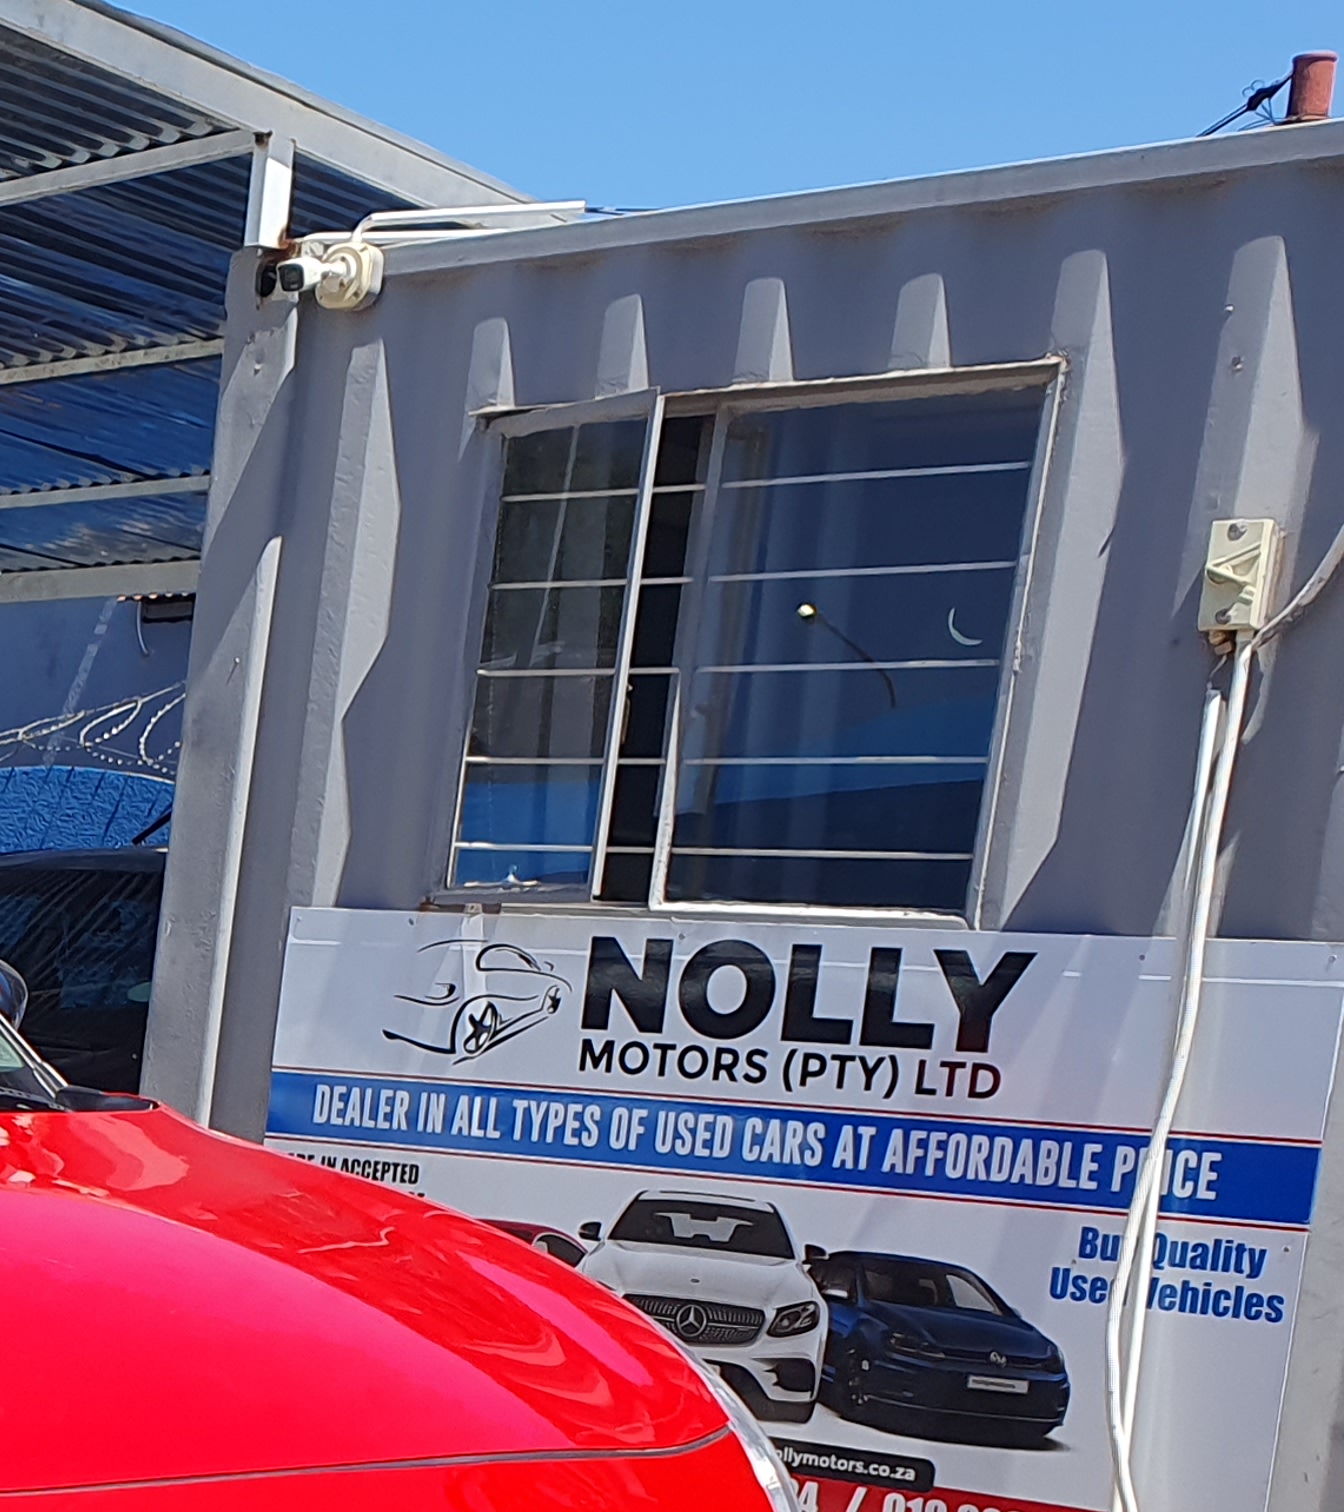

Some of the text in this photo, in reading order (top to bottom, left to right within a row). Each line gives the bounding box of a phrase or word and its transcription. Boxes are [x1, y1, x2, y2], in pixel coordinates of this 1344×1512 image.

[580, 936, 1039, 1054] NOLLY
[578, 1038, 1003, 1100] MOTORS (PTY) LTD
[313, 1083, 410, 1132] DEALER
[417, 1091, 447, 1135] IN
[450, 1094, 502, 1140] ALL
[512, 1098, 600, 1149] TYPES
[608, 1106, 649, 1151] OF
[654, 1110, 733, 1159] USED
[742, 1115, 826, 1168] CARS
[832, 1124, 877, 1171] AT
[881, 1129, 1103, 1190] AFFORDABLE
[340, 1157, 420, 1185] ACCEPTED
[1077, 1225, 1267, 1280] Bu Quality
[1049, 1266, 1117, 1304] Use
